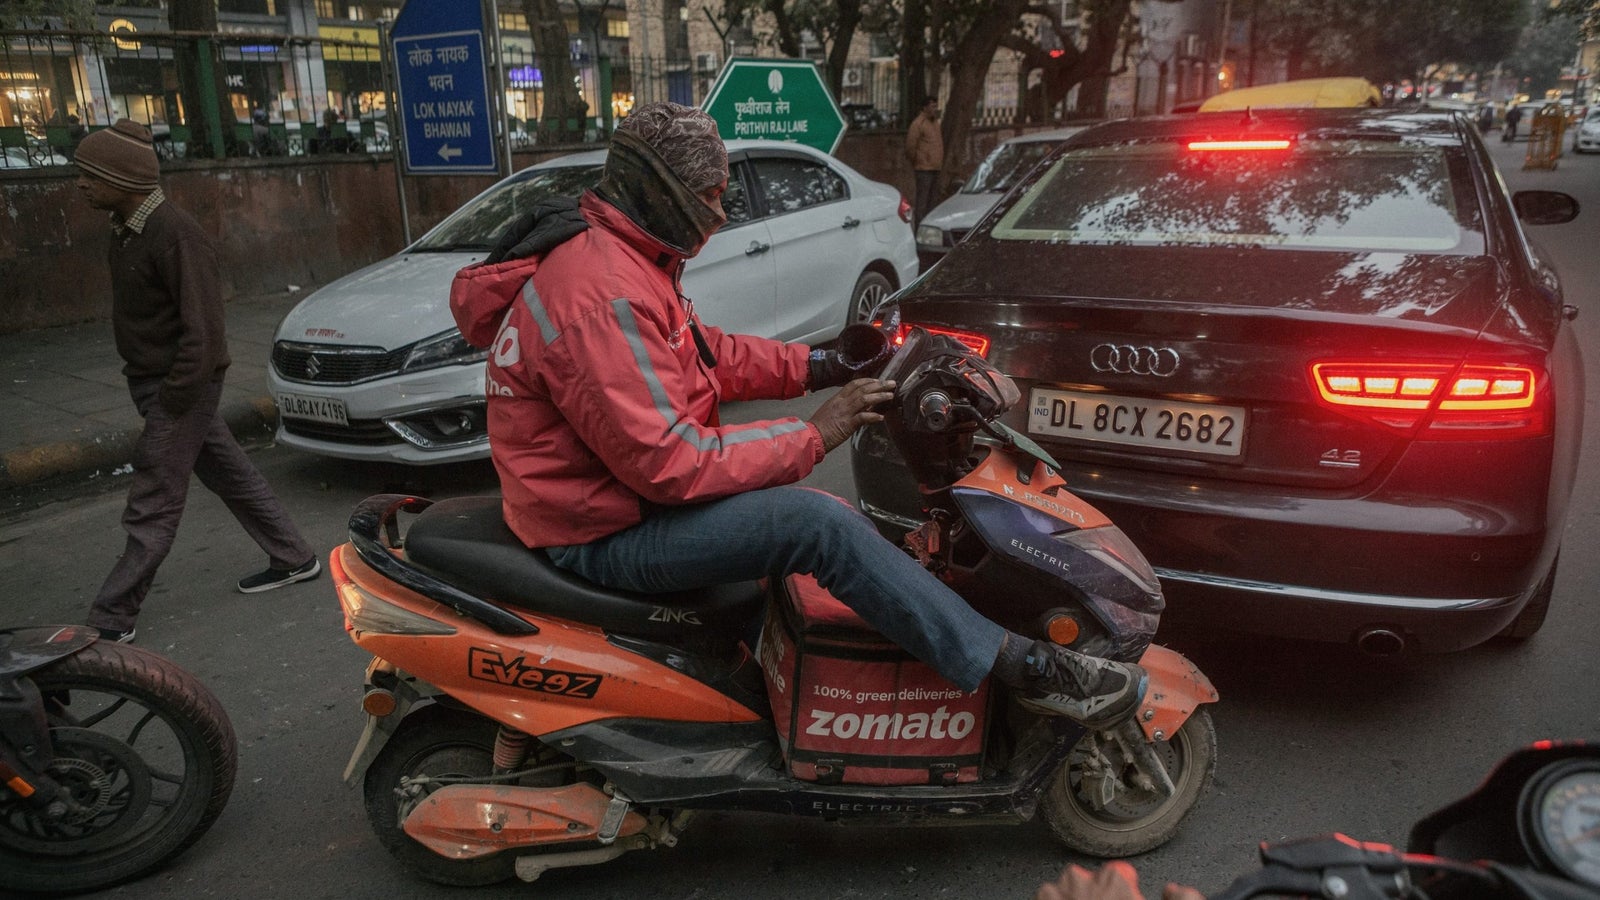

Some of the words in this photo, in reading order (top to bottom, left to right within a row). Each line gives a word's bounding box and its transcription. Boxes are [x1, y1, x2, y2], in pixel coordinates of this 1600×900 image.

[407, 43, 433, 67] लोक
[436, 45, 469, 65] नायक
[428, 74, 454, 92] भवन
[413, 102, 436, 119] LOK
[438, 100, 475, 118] NAYAK
[734, 96, 772, 121] पृथ्वीराज
[775, 97, 790, 115] लेन
[424, 122, 471, 138] BHAWAN
[734, 121, 769, 135] PRITHVI
[787, 119, 808, 133] LANE
[1034, 407, 1049, 417] IND
[1051, 399, 1083, 430] DL
[1093, 403, 1147, 437] 8CX
[1156, 410, 1235, 446] 2682
[1011, 539, 1071, 571] ELECTRIC
[648, 605, 702, 625] ZING
[813, 684, 852, 700] 100%
[856, 689, 896, 704] green
[899, 687, 962, 701] deliveries
[806, 705, 975, 740] zomato
[813, 801, 918, 812] ELECTRIC
